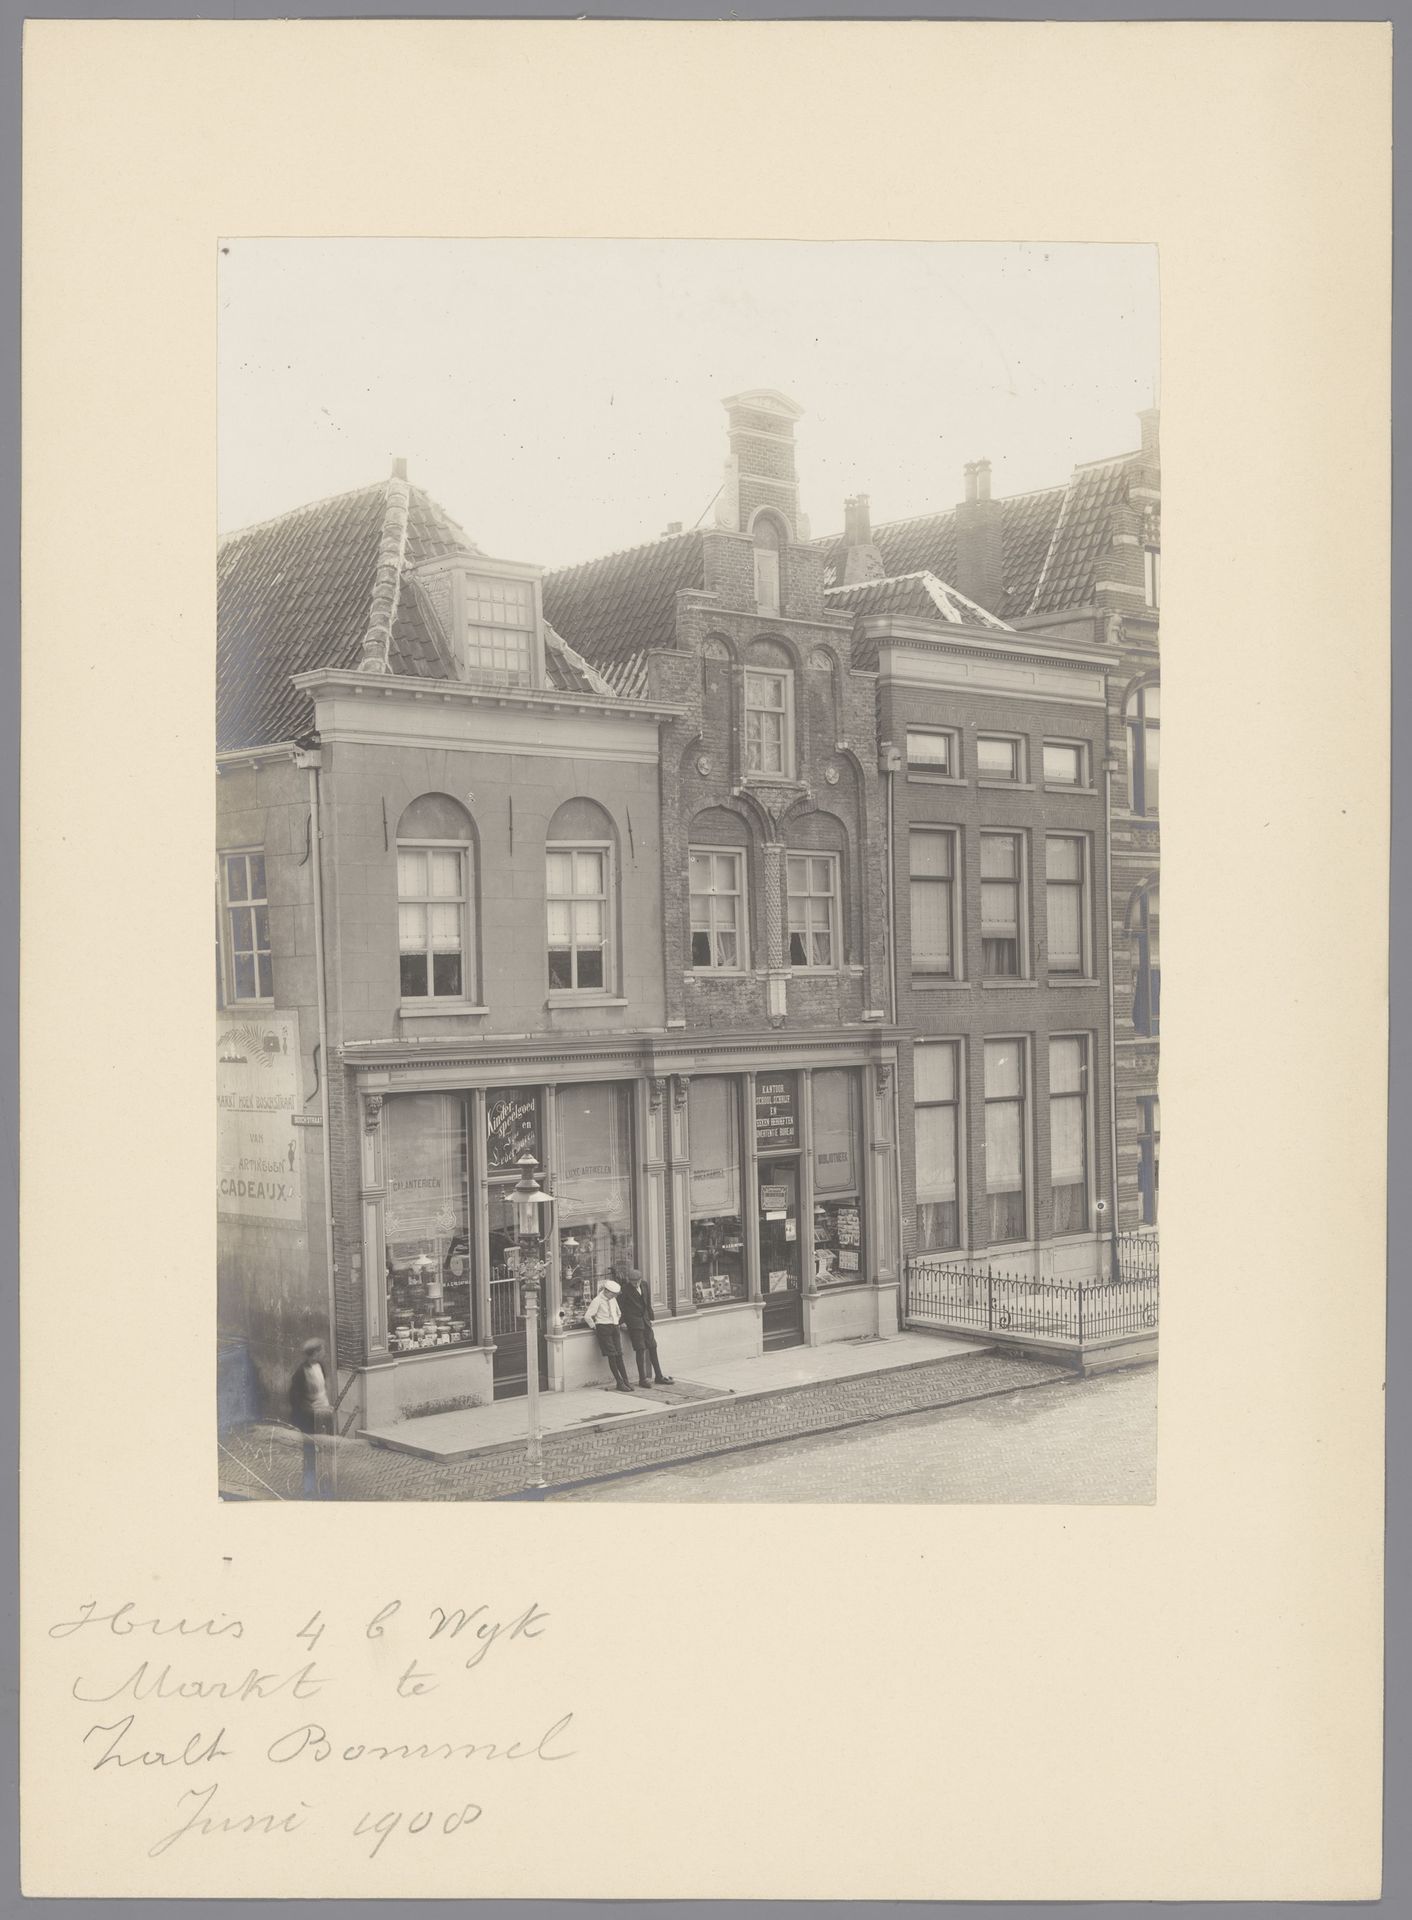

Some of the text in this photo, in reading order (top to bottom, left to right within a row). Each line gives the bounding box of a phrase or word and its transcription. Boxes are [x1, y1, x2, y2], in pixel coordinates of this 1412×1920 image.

[762, 1084, 785, 1094] KANTOOR
[498, 1098, 535, 1138] speelgoed
[770, 1106, 777, 1115] EN
[522, 1121, 532, 1129] en
[249, 1133, 264, 1144] VAN
[239, 1158, 286, 1174] ARTIKELEN
[220, 1178, 287, 1202] CADEAUX
[48, 1600, 244, 1639] Huis
[296, 1610, 325, 1651] 4
[72, 1659, 440, 1703] Markt te
[82, 1712, 579, 1771] Zalt Bommel
[148, 1783, 483, 1859] Juni 1908
